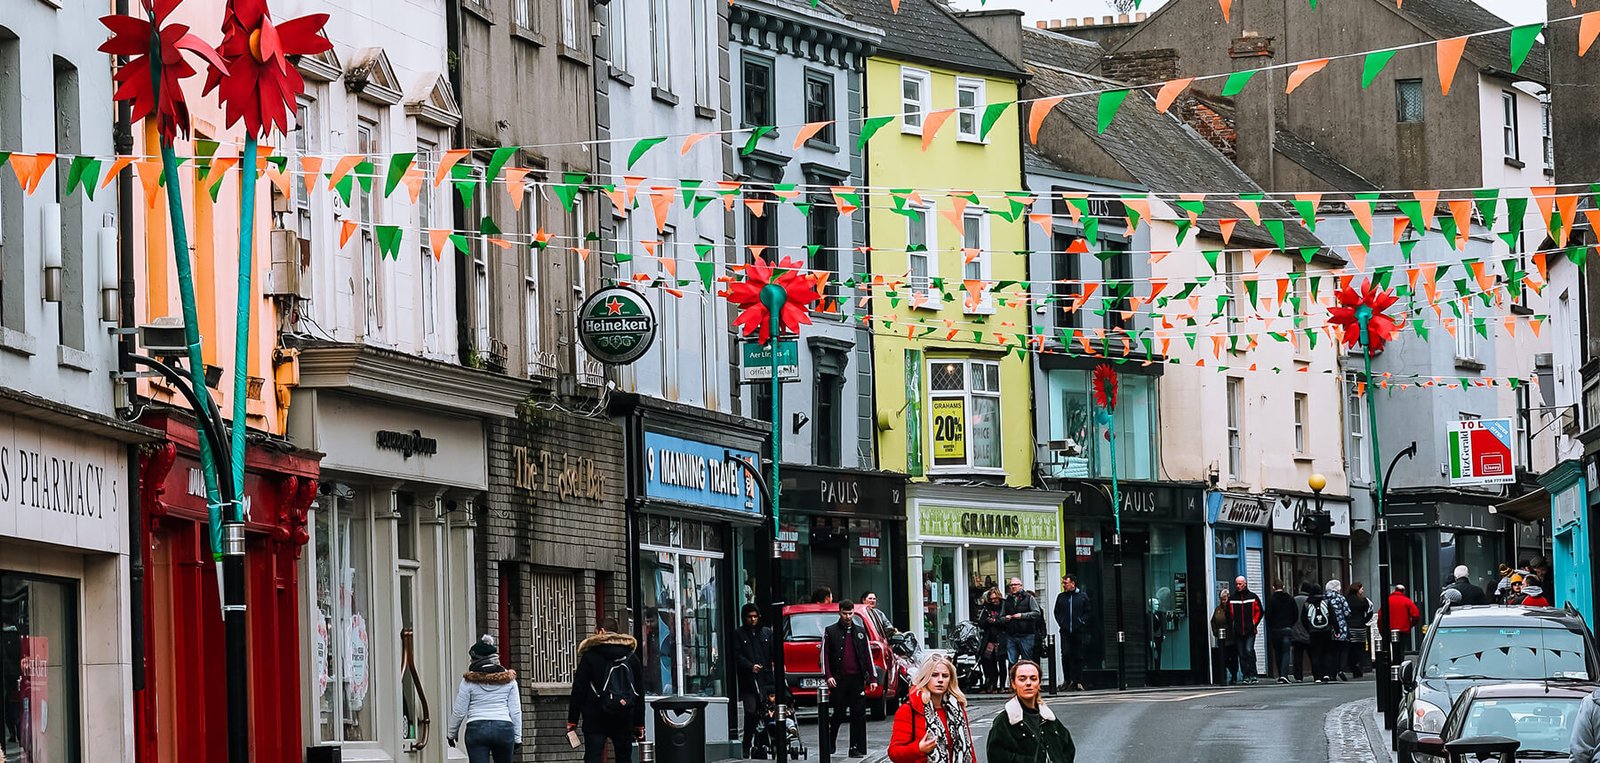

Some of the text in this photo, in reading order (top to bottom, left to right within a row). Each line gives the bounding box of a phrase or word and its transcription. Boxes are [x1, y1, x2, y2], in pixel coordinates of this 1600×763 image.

[585, 319, 647, 332] Heineken
[933, 402, 963, 410] GRAHAMS
[1460, 421, 1475, 429] TO
[1460, 430, 1471, 478] FitzGerald
[512, 446, 538, 491] The
[586, 458, 606, 501] Bar
[647, 446, 655, 481] 9
[660, 448, 706, 491] MANNING
[708, 458, 740, 496] TRAVEL
[19, 449, 104, 520] PHARMACY
[112, 480, 118, 513] 5
[820, 480, 859, 505] PAULS
[892, 488, 900, 504] 12
[1187, 496, 1195, 510] 14
[961, 512, 1020, 538] GRAHAMS
